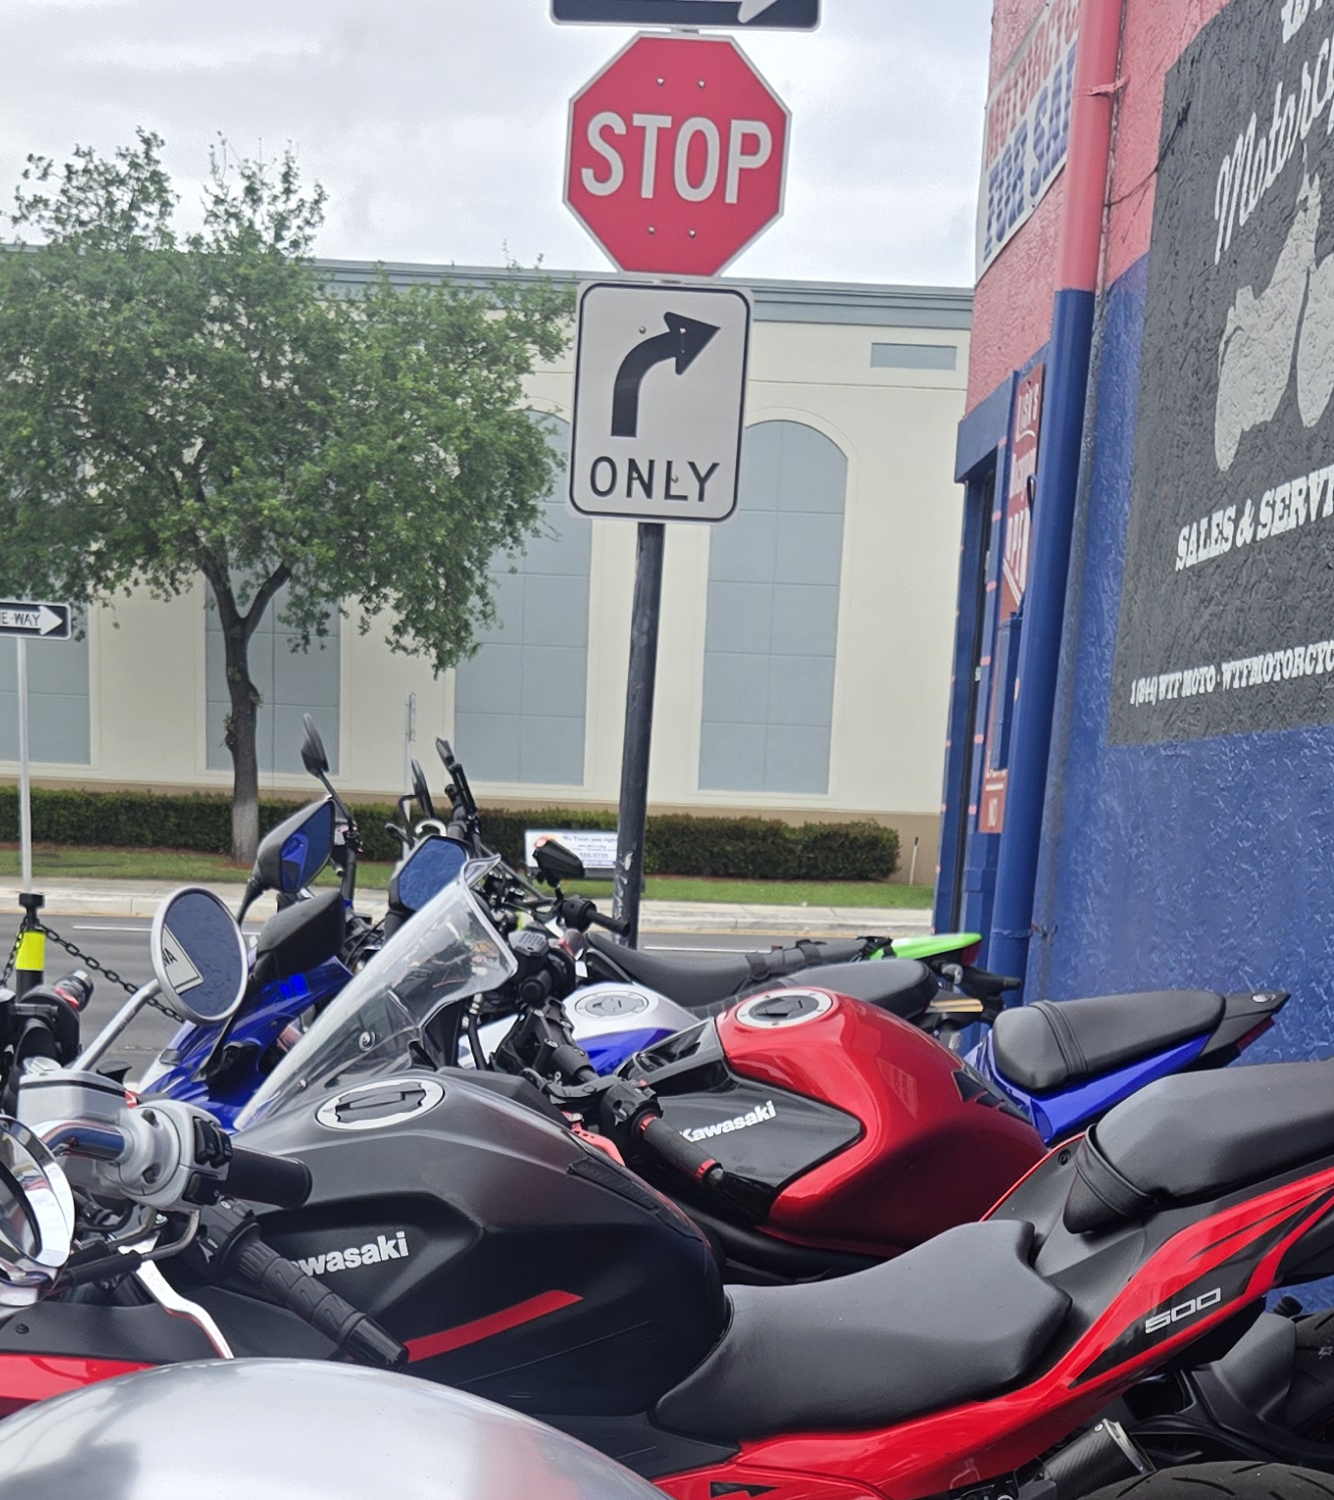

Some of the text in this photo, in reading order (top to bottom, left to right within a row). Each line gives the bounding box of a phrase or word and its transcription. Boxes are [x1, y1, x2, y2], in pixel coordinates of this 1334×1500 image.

[985, 0, 1080, 172] MOTORCYC
[580, 111, 773, 204] STOP
[983, 118, 1028, 263] FOR
[589, 456, 720, 502] ONLY
[1175, 505, 1236, 571] SALES
[1236, 499, 1255, 547] &
[14, 612, 41, 627] WAY
[1159, 671, 1182, 700] WTF
[1181, 665, 1216, 697] MOTO
[291, 1231, 409, 1277] wasaki
[1145, 1287, 1221, 1334] 500
